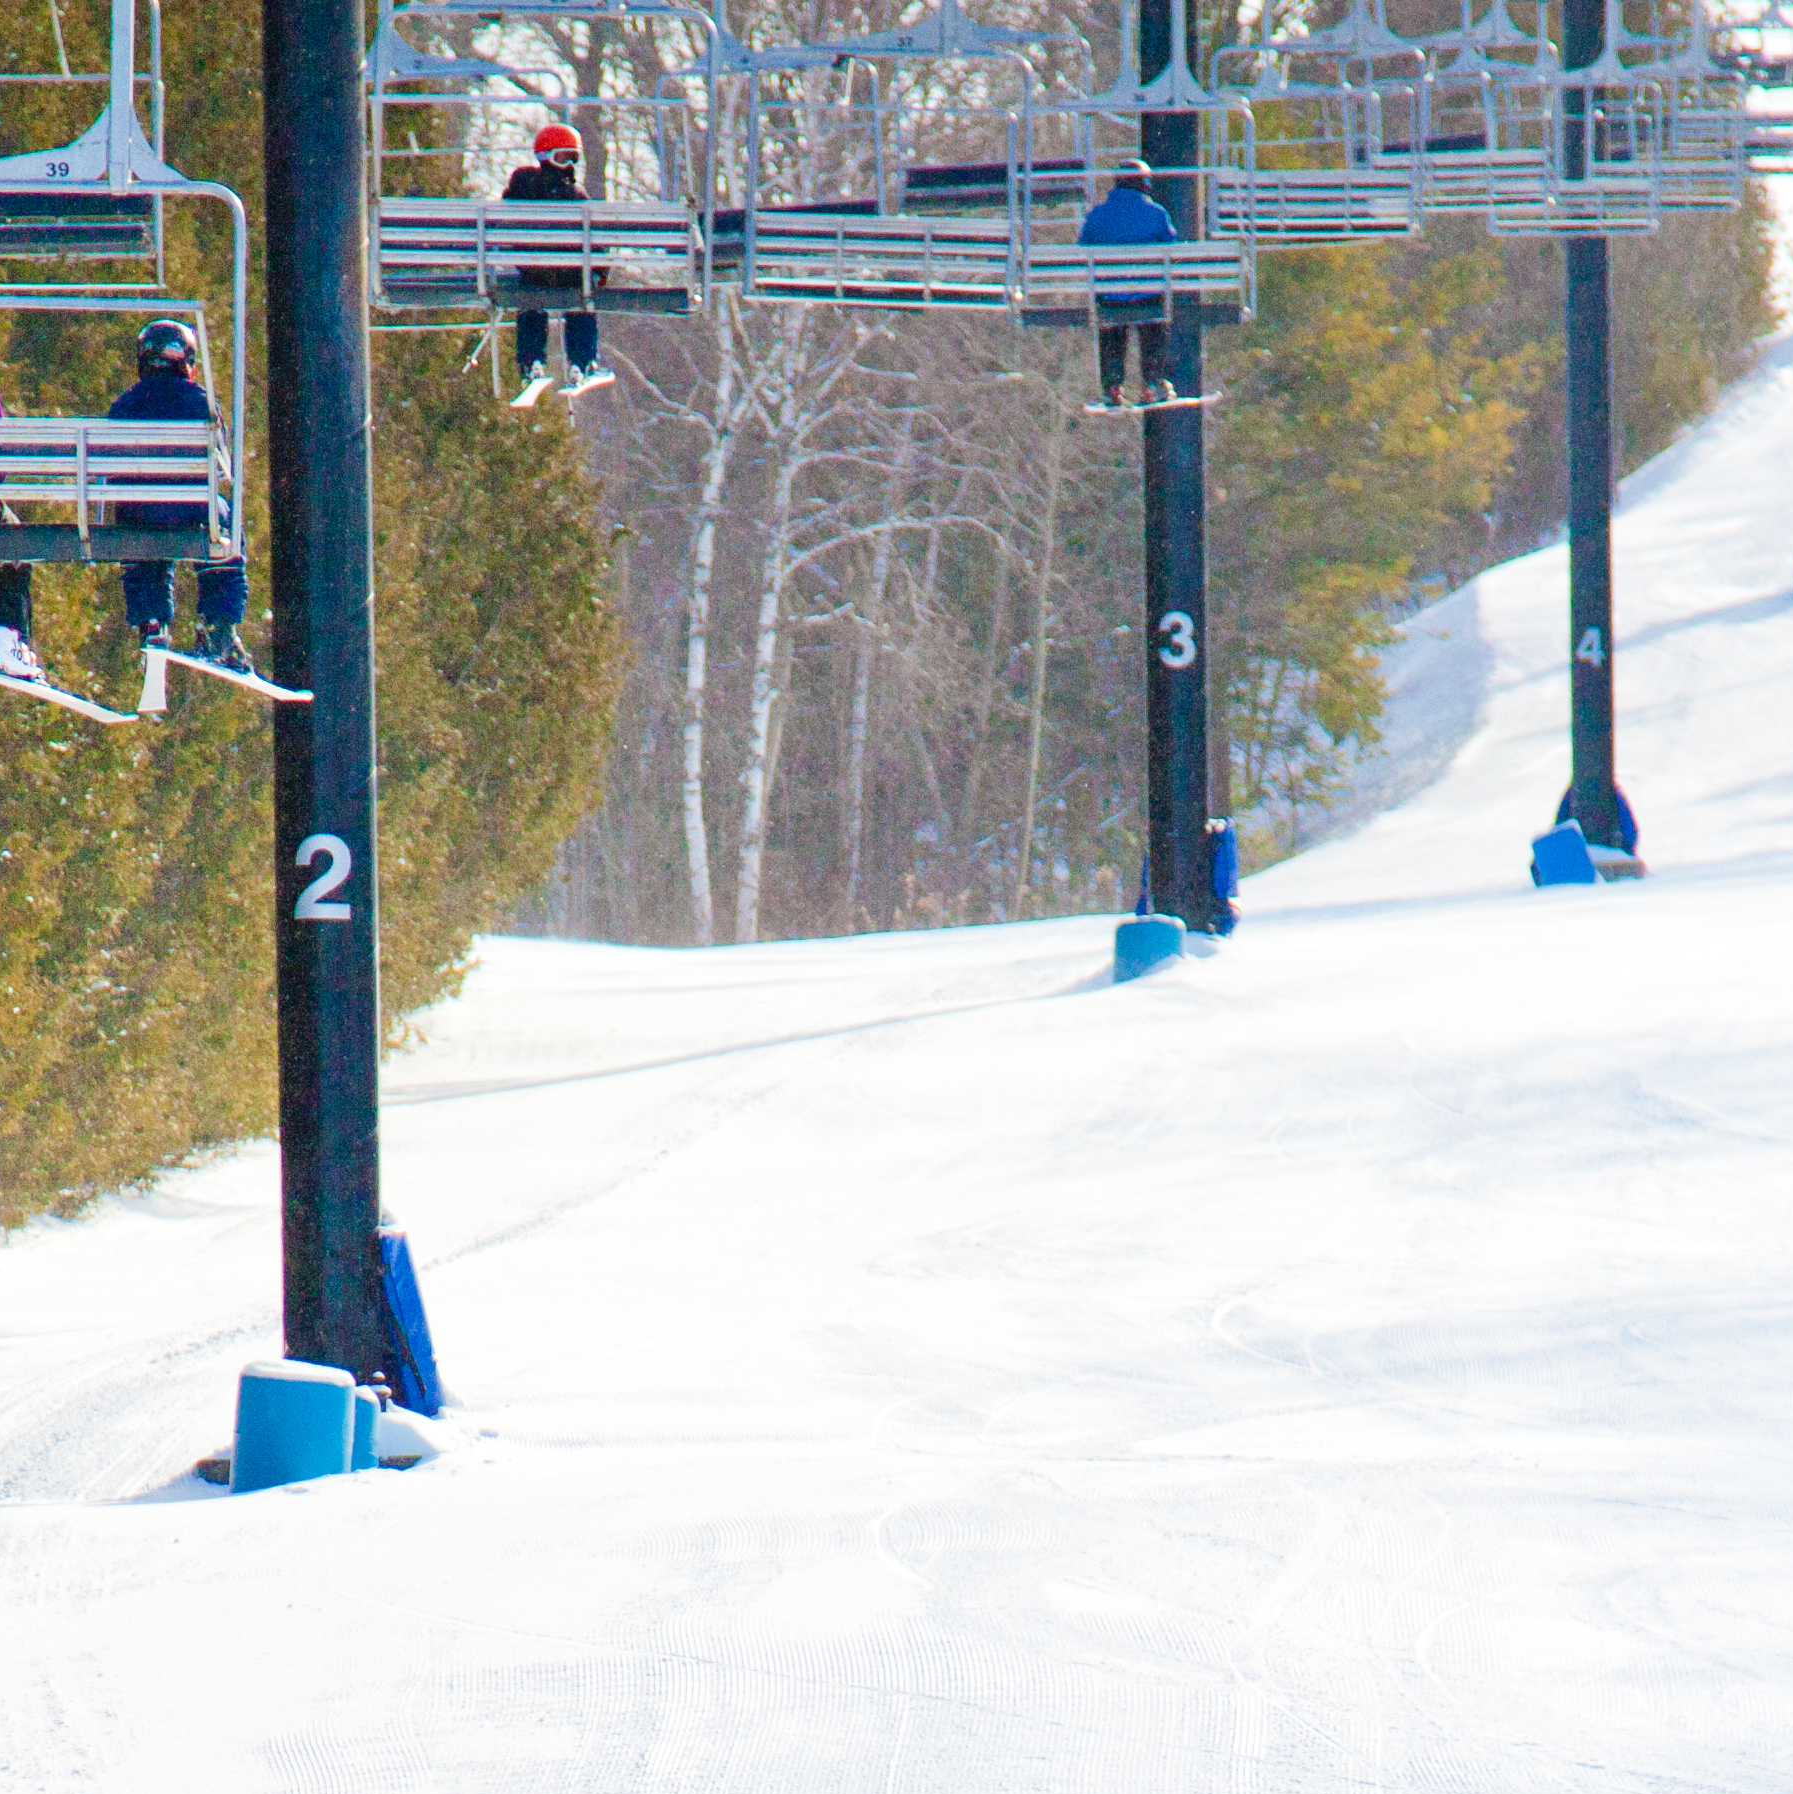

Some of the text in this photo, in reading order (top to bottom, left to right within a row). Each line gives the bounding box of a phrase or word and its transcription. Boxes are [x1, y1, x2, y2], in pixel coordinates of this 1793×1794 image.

[45, 161, 70, 178] 39
[1158, 608, 1197, 670] 3
[1575, 625, 1607, 668] 4
[294, 832, 353, 921] 2
